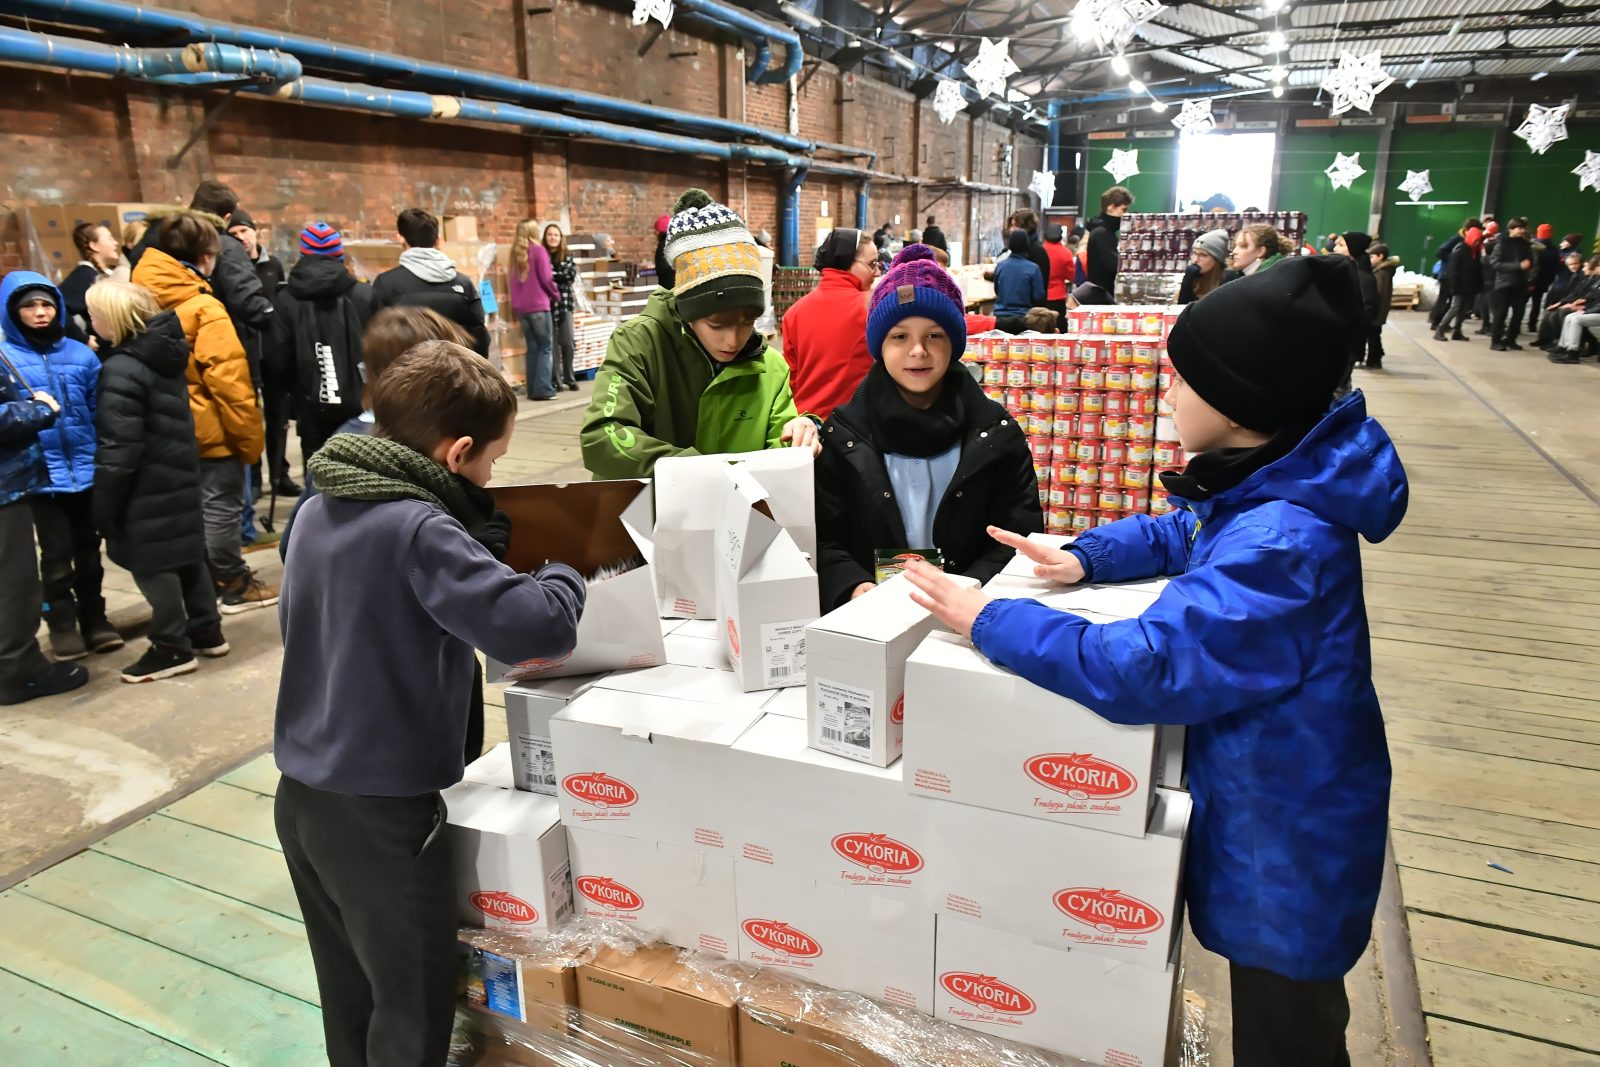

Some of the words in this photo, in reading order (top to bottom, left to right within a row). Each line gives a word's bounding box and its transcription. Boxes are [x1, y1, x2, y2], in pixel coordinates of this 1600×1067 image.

[1039, 761, 1120, 790] CYKORIA
[571, 779, 628, 800] CYKORIA
[1033, 797, 1064, 810] Tradycja
[1065, 800, 1087, 811] jakość
[1090, 801, 1121, 812] zaufanie
[843, 839, 910, 866] CYKORIA
[582, 880, 634, 905] CYKORIA
[478, 896, 529, 919] CYKORIA
[1067, 894, 1147, 925] CYKORIA
[751, 923, 810, 952] CYKORIA
[1062, 928, 1091, 942] Tradycja
[1093, 933, 1115, 943] jakość
[1117, 935, 1148, 946] zaufanie
[952, 977, 1021, 1009] CYKORIA
[615, 1018, 646, 1033] CANNED
[648, 1027, 692, 1047] PINEAPPLE
